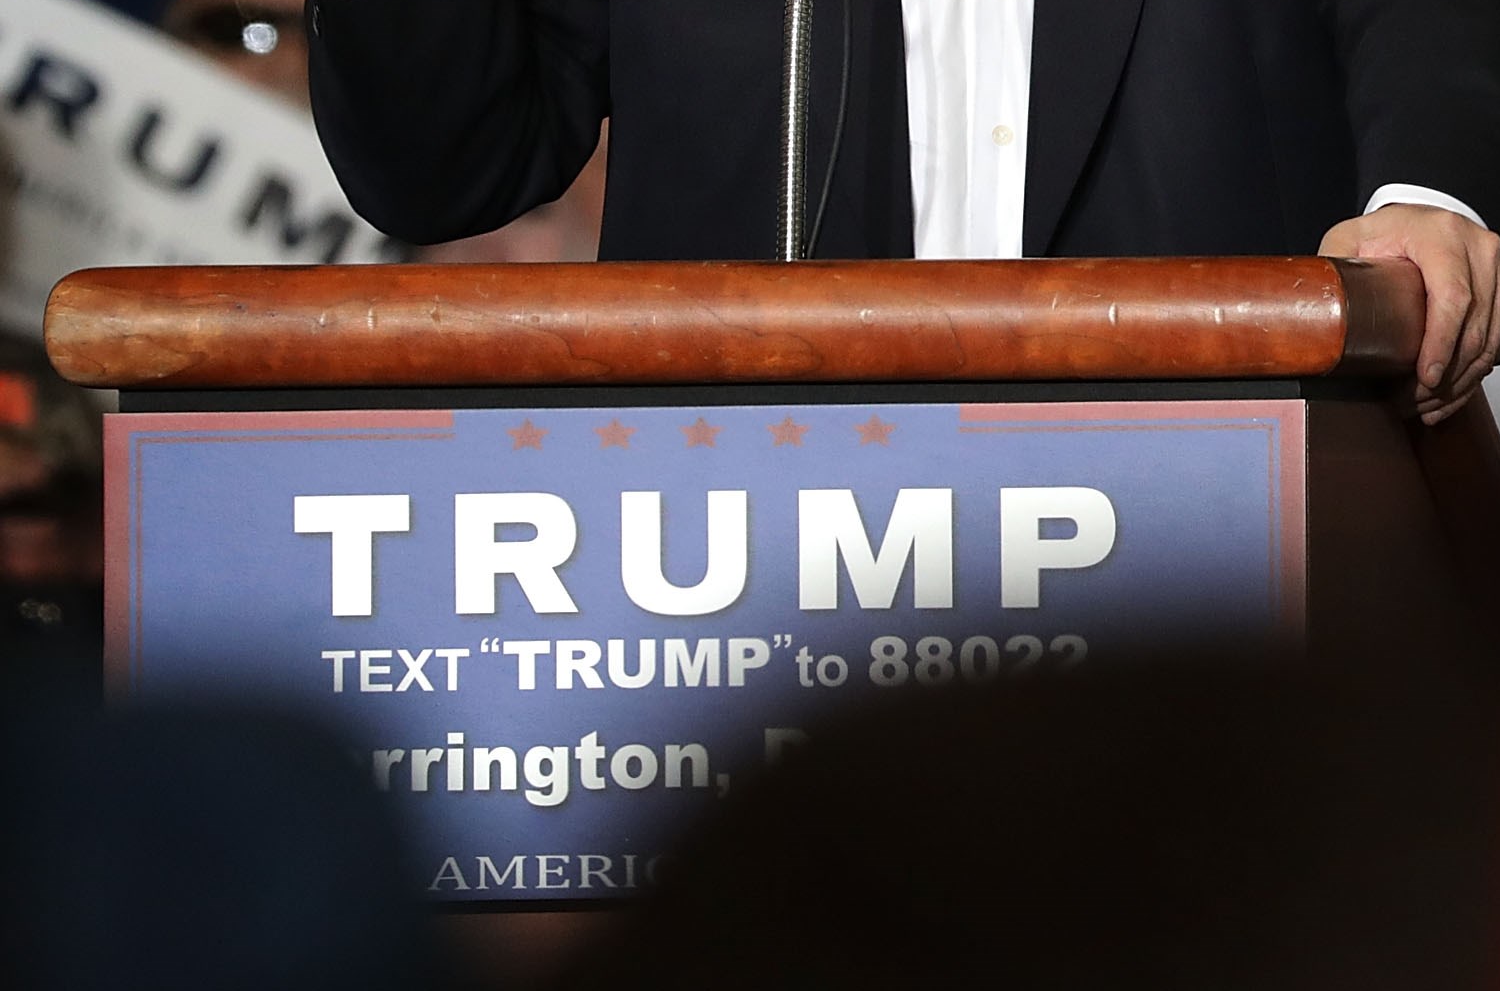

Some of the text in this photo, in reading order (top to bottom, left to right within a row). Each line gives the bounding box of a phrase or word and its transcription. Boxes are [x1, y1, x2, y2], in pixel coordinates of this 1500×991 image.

[4, 44, 415, 263] RUM
[293, 485, 1118, 617] TRUMP
[321, 648, 470, 693] TEXT
[796, 646, 849, 688] to
[868, 634, 1090, 688] 88022
[371, 729, 730, 808] rrington,
